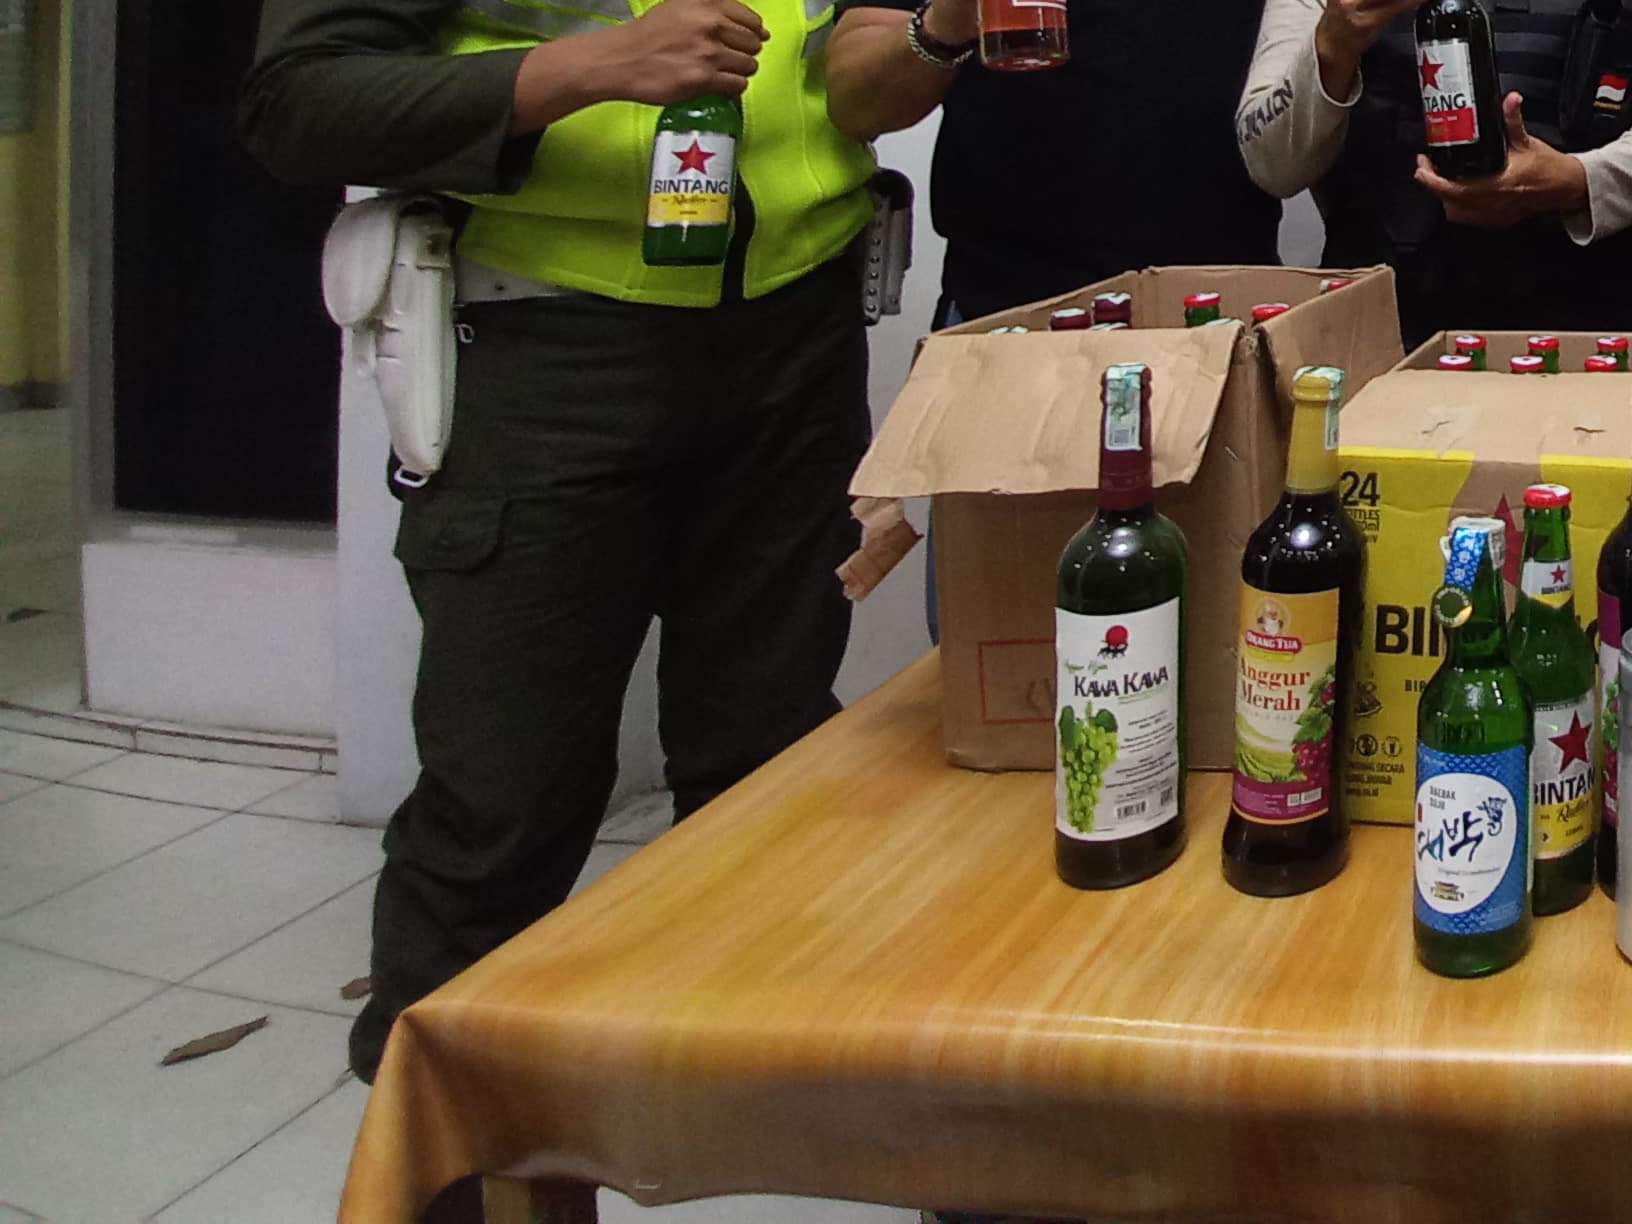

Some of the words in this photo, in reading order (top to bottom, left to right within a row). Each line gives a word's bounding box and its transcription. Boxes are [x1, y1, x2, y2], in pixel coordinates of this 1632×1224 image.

[1424, 93, 1467, 112] TANG
[653, 179, 729, 194] BINTANG
[1341, 470, 1380, 506] 24
[1074, 675, 1119, 697] KAWA
[1124, 665, 1168, 695] KAWA
